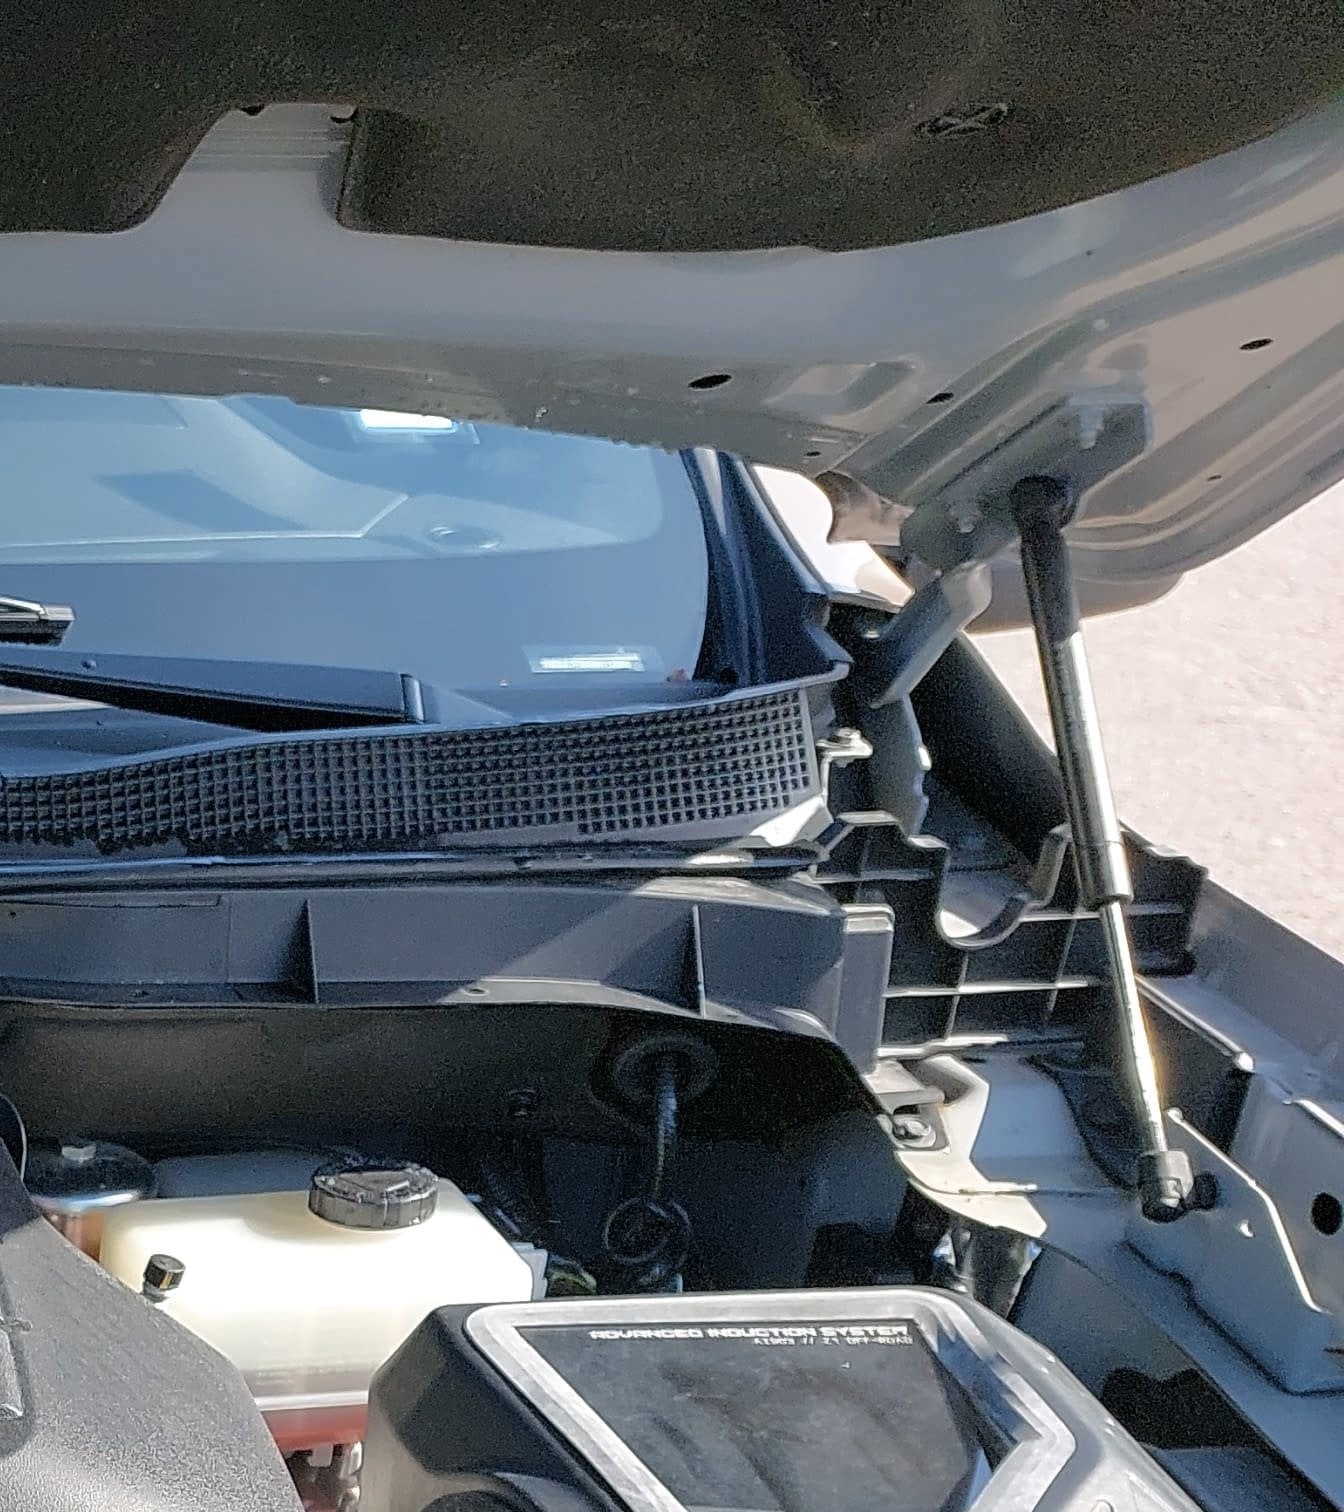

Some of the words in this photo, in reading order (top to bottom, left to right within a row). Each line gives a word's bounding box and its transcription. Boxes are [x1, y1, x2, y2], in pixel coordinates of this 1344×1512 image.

[588, 1329, 704, 1340] ADVANCED
[708, 1327, 817, 1339] INDUCTION
[820, 1326, 907, 1337] SYSTEM
